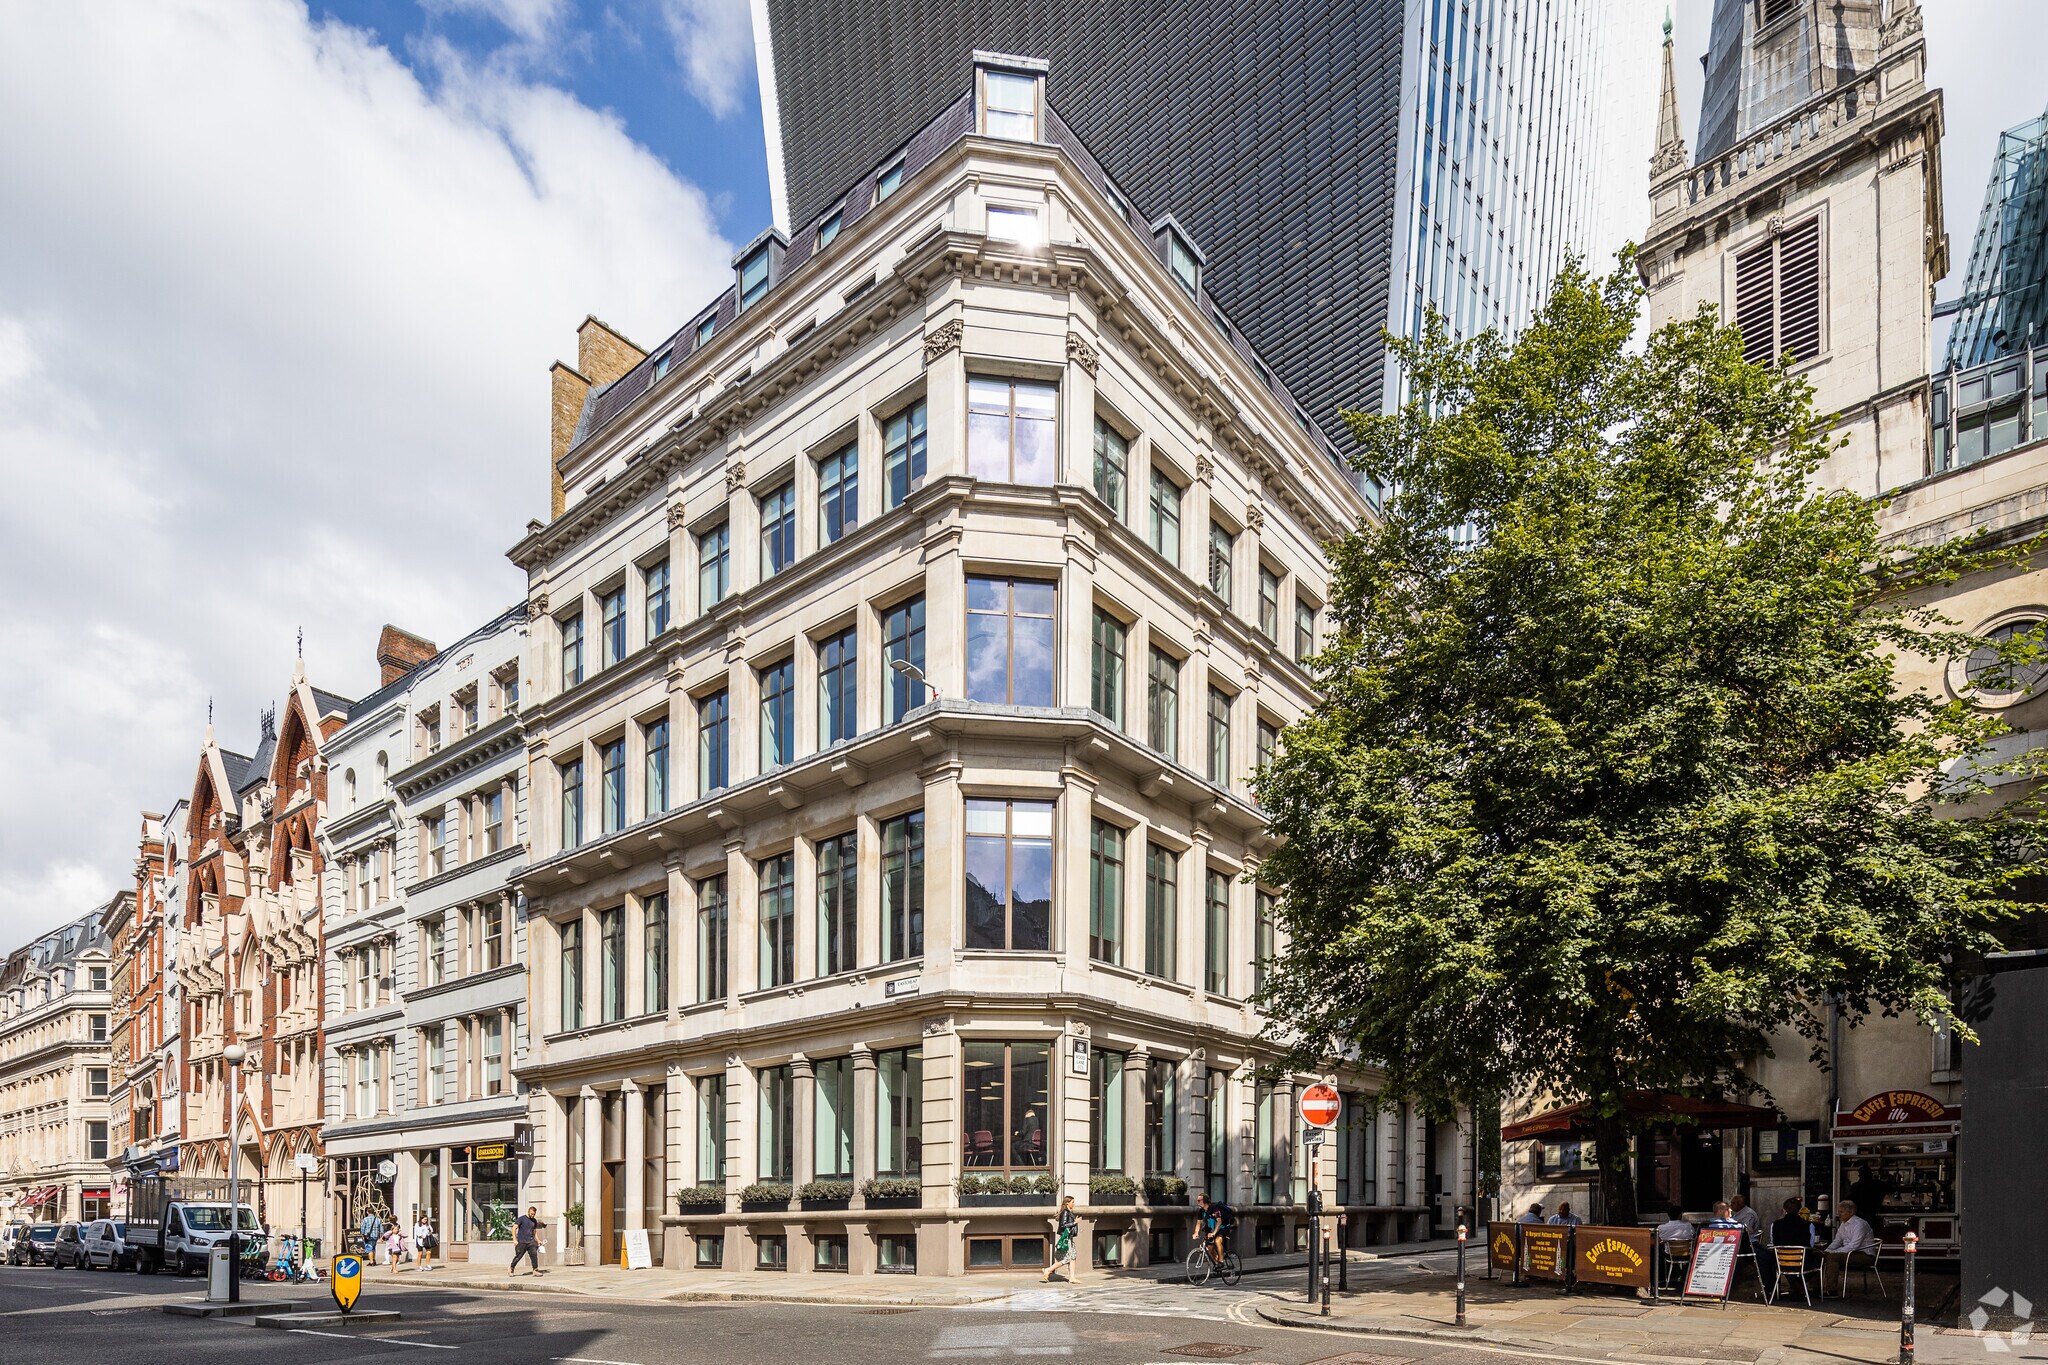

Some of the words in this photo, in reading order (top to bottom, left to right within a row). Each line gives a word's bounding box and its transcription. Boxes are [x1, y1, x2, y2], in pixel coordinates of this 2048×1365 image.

[1853, 1097, 1886, 1122] CAFFE
[1889, 1092, 1944, 1118] ESPRESSO
[1888, 1108, 1908, 1122] illy
[1585, 1242, 1606, 1264] CAFFE
[1606, 1238, 1643, 1266] ESPRESSO
